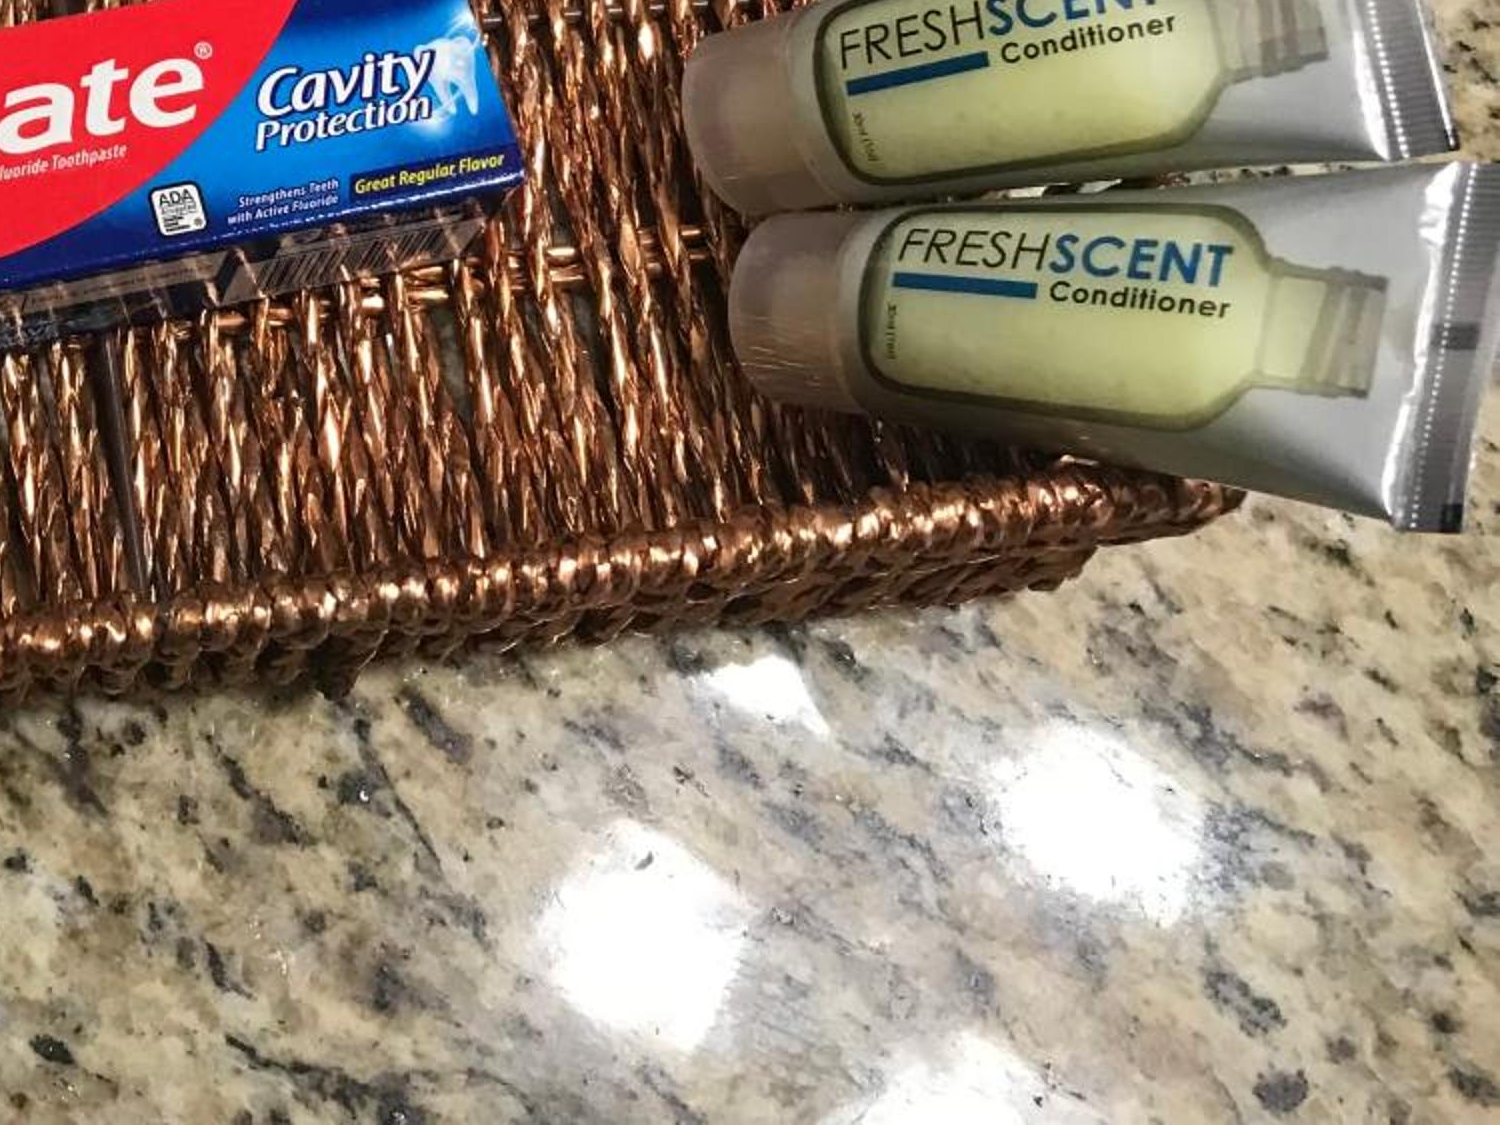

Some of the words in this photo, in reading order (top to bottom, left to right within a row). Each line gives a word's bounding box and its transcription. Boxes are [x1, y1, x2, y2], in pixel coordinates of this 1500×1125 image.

[1000, 15, 1176, 64] Conditioner
[256, 48, 436, 118] Cavity
[255, 92, 432, 152] Protection
[51, 142, 128, 170] Toothpaste
[354, 174, 396, 195] Great
[399, 163, 456, 189] Regular
[458, 152, 506, 178] Flavor
[158, 188, 194, 207] ADA
[227, 210, 253, 225] with
[255, 203, 290, 220] Active
[292, 193, 339, 213] Fluoride
[238, 185, 308, 208] Strengthens
[308, 178, 339, 194] Teeth
[897, 228, 1235, 288] FRESHSCENT
[1049, 279, 1232, 319] Conditioner
